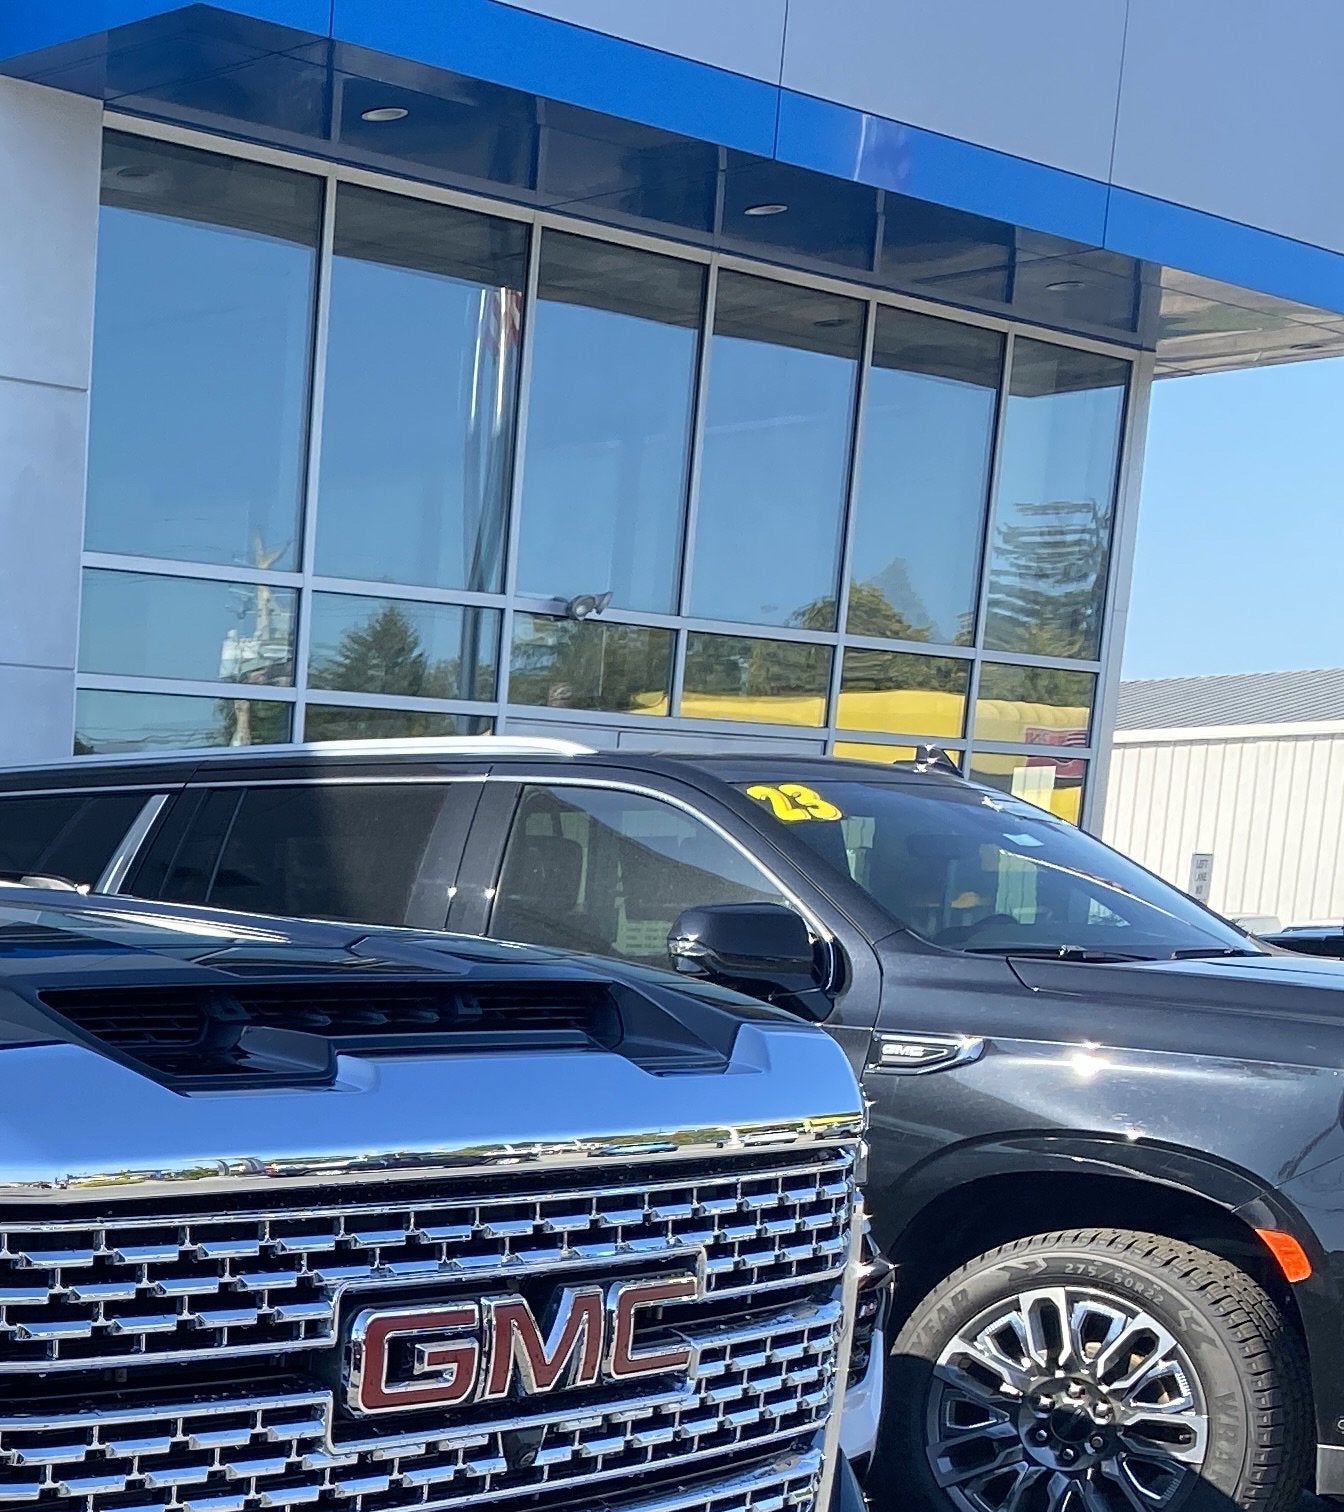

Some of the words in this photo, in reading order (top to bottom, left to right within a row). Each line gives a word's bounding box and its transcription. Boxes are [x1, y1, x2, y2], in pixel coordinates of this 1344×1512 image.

[746, 784, 843, 821] 23
[882, 1043, 925, 1058] GMC
[1064, 1263, 1164, 1306] 275/50R22
[347, 1275, 698, 1414] GMC
